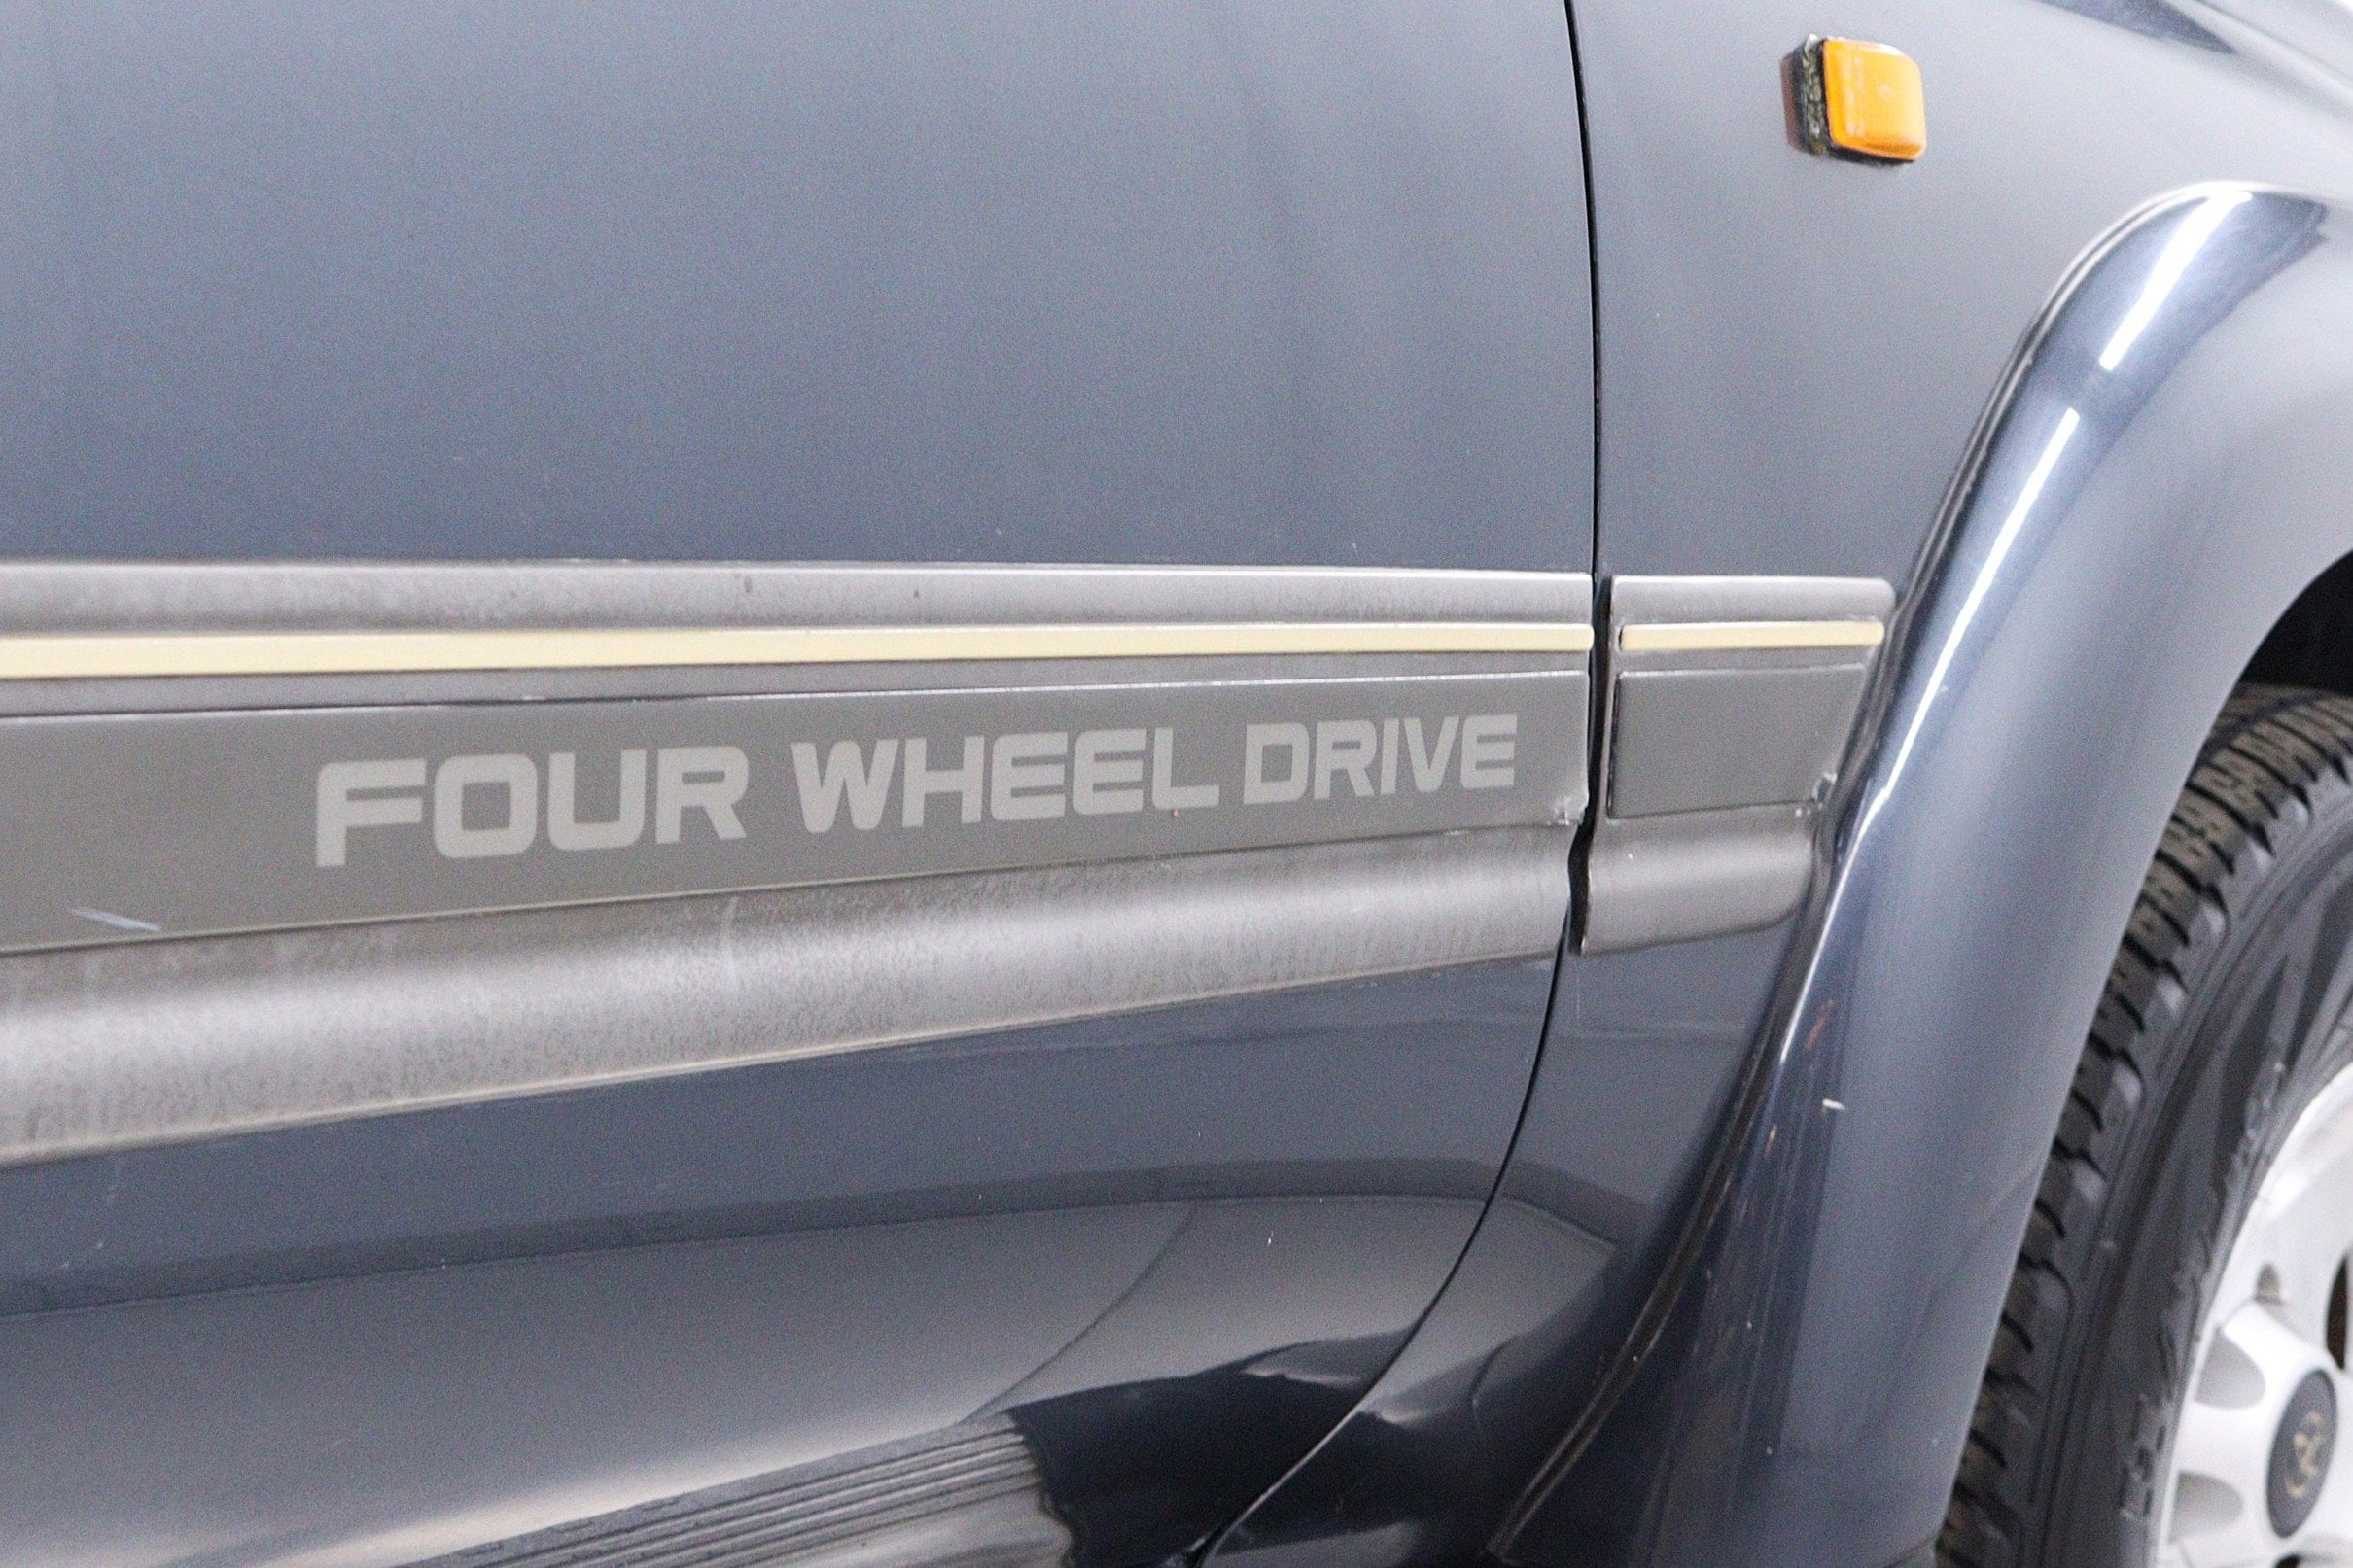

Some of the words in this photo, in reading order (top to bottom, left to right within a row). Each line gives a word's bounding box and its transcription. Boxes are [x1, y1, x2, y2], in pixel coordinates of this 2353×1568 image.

[315, 745, 749, 868] FOUR
[790, 727, 1220, 834] WHEEL
[1243, 714, 1518, 805] DRIVE
